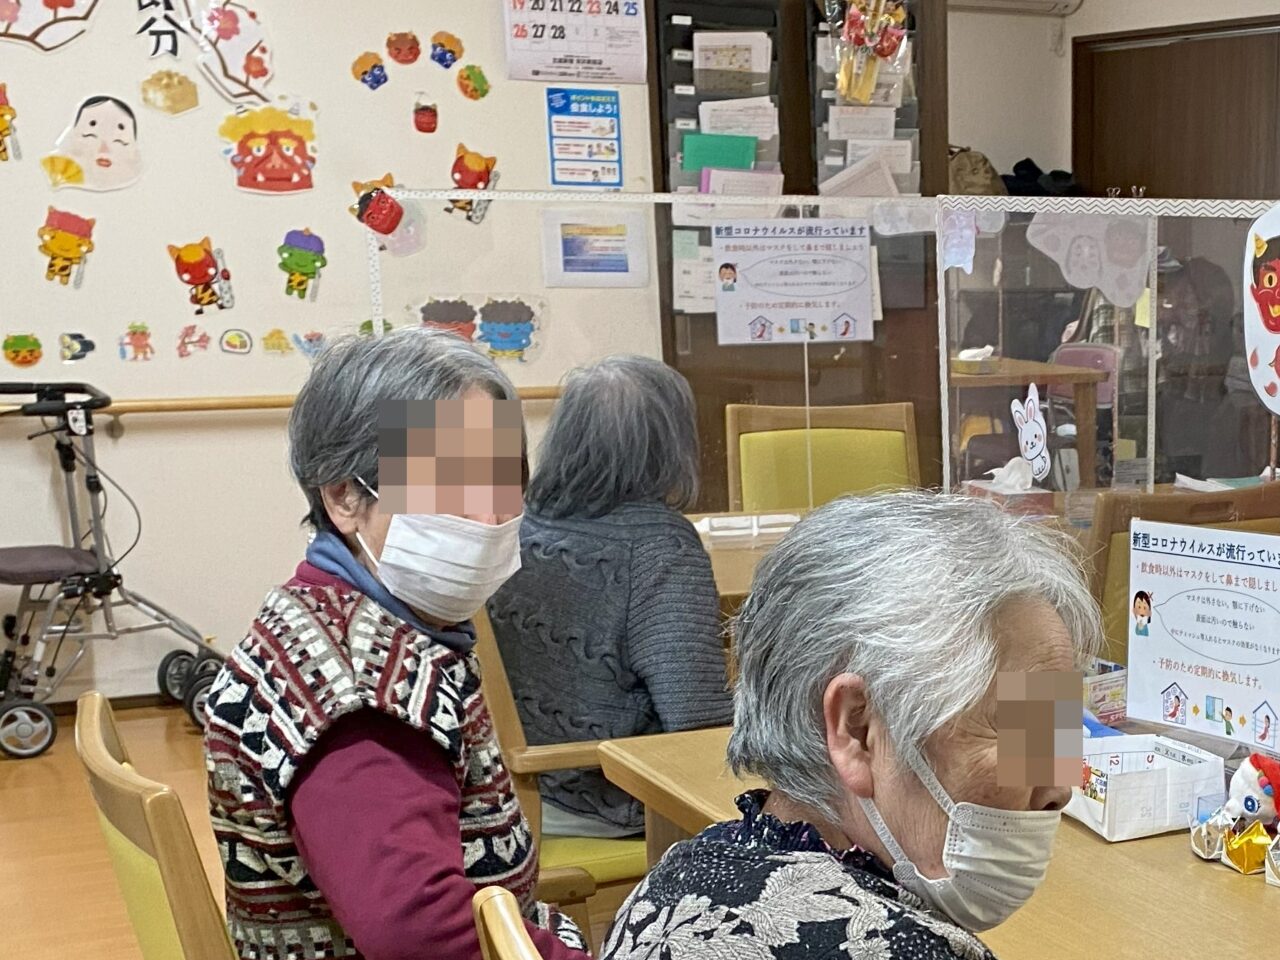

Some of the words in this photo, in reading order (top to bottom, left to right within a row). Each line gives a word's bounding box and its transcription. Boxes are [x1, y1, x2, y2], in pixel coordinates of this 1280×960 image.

[530, 0, 545, 11] 20
[551, 0, 563, 12] 21
[568, 0, 583, 13] 22
[588, 0, 601, 14] 23
[605, 1, 619, 16] 24
[624, 2, 638, 16] 25
[513, 24, 528, 39] 26
[532, 24, 545, 39] 27
[551, 25, 566, 40] 28
